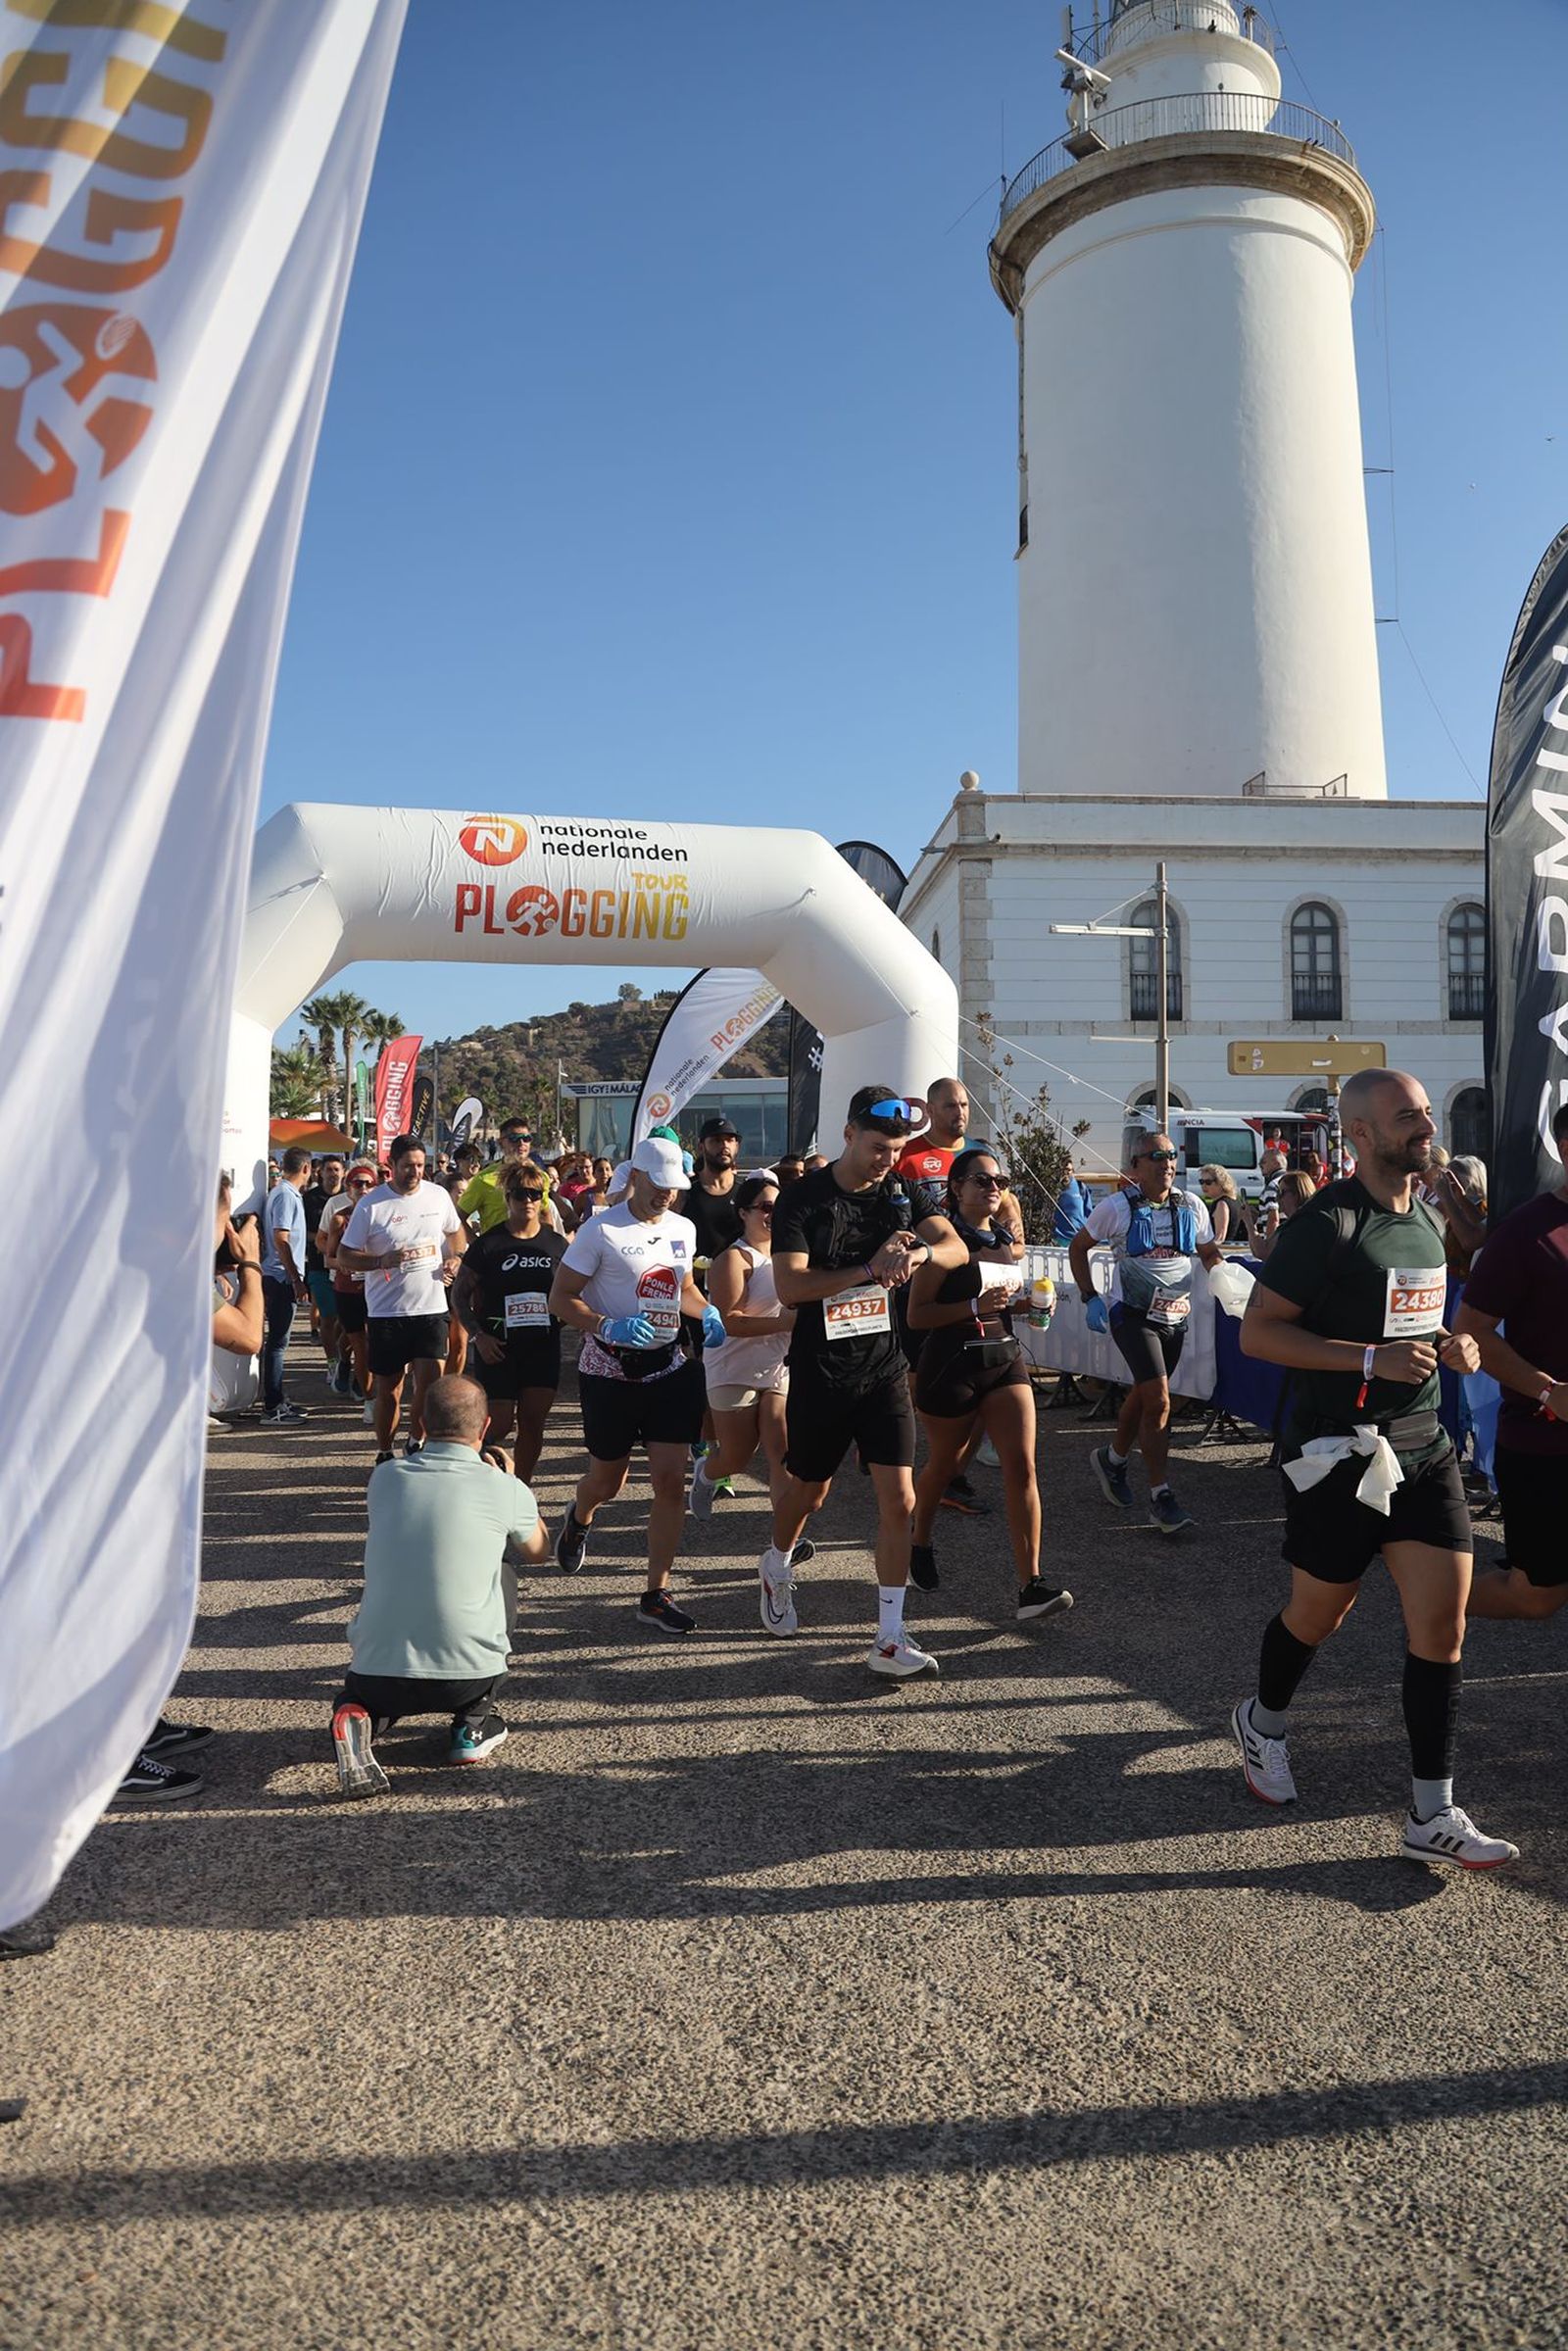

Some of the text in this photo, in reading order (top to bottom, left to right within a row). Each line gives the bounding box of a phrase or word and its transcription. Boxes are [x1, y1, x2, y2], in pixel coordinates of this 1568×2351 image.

[540, 824, 649, 841] nationale
[542, 840, 688, 862] nederlanden
[631, 871, 689, 892] TOUR
[454, 883, 690, 942] PLOGGING
[664, 1057, 695, 1092] nationale
[671, 1054, 710, 1097] nederlanden
[588, 1084, 605, 1094] IGY
[519, 1256, 552, 1268] asics
[645, 1276, 675, 1294] PONLE
[831, 1299, 882, 1320] 24937
[1395, 1289, 1444, 1310] 24380
